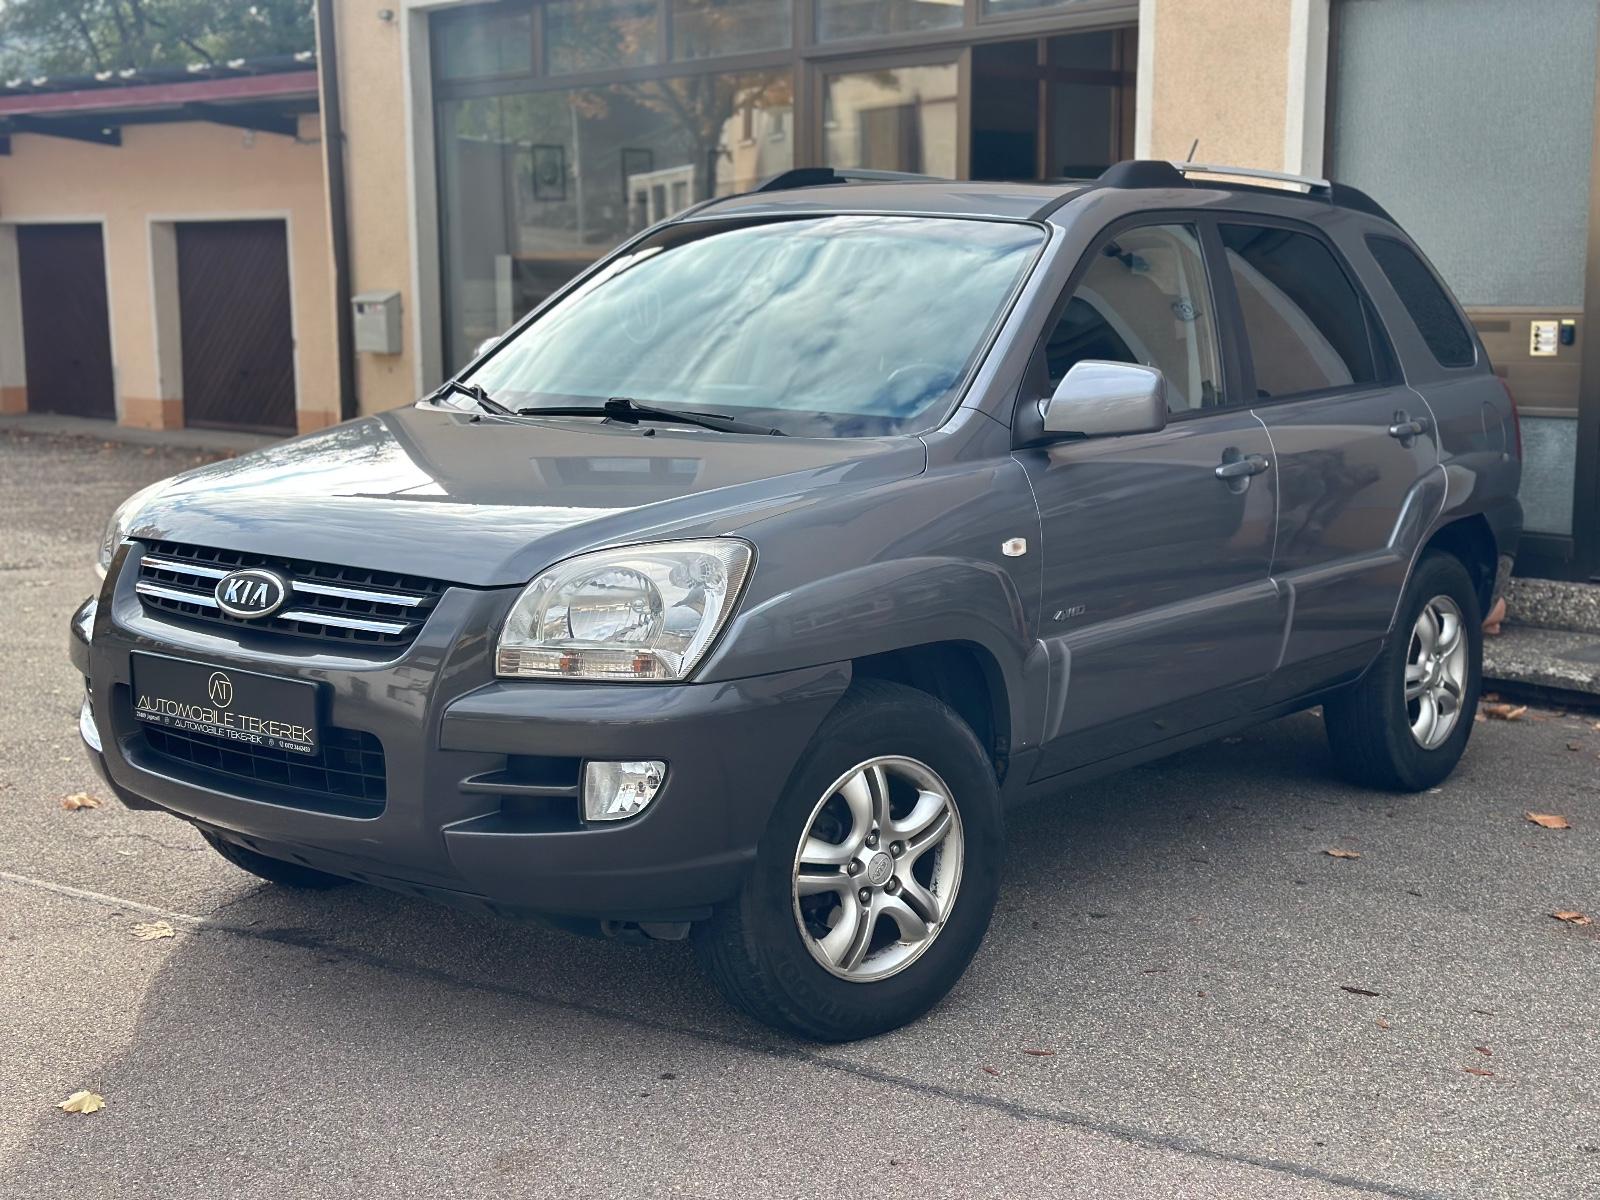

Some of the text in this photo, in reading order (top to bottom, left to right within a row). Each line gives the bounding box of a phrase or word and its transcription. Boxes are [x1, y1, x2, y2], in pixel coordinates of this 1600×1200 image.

[224, 578, 269, 608] KIA
[137, 695, 313, 743] AUTOMOBILE TEKEREK
[174, 719, 262, 744] AUTOMOBILE TEKEREK
